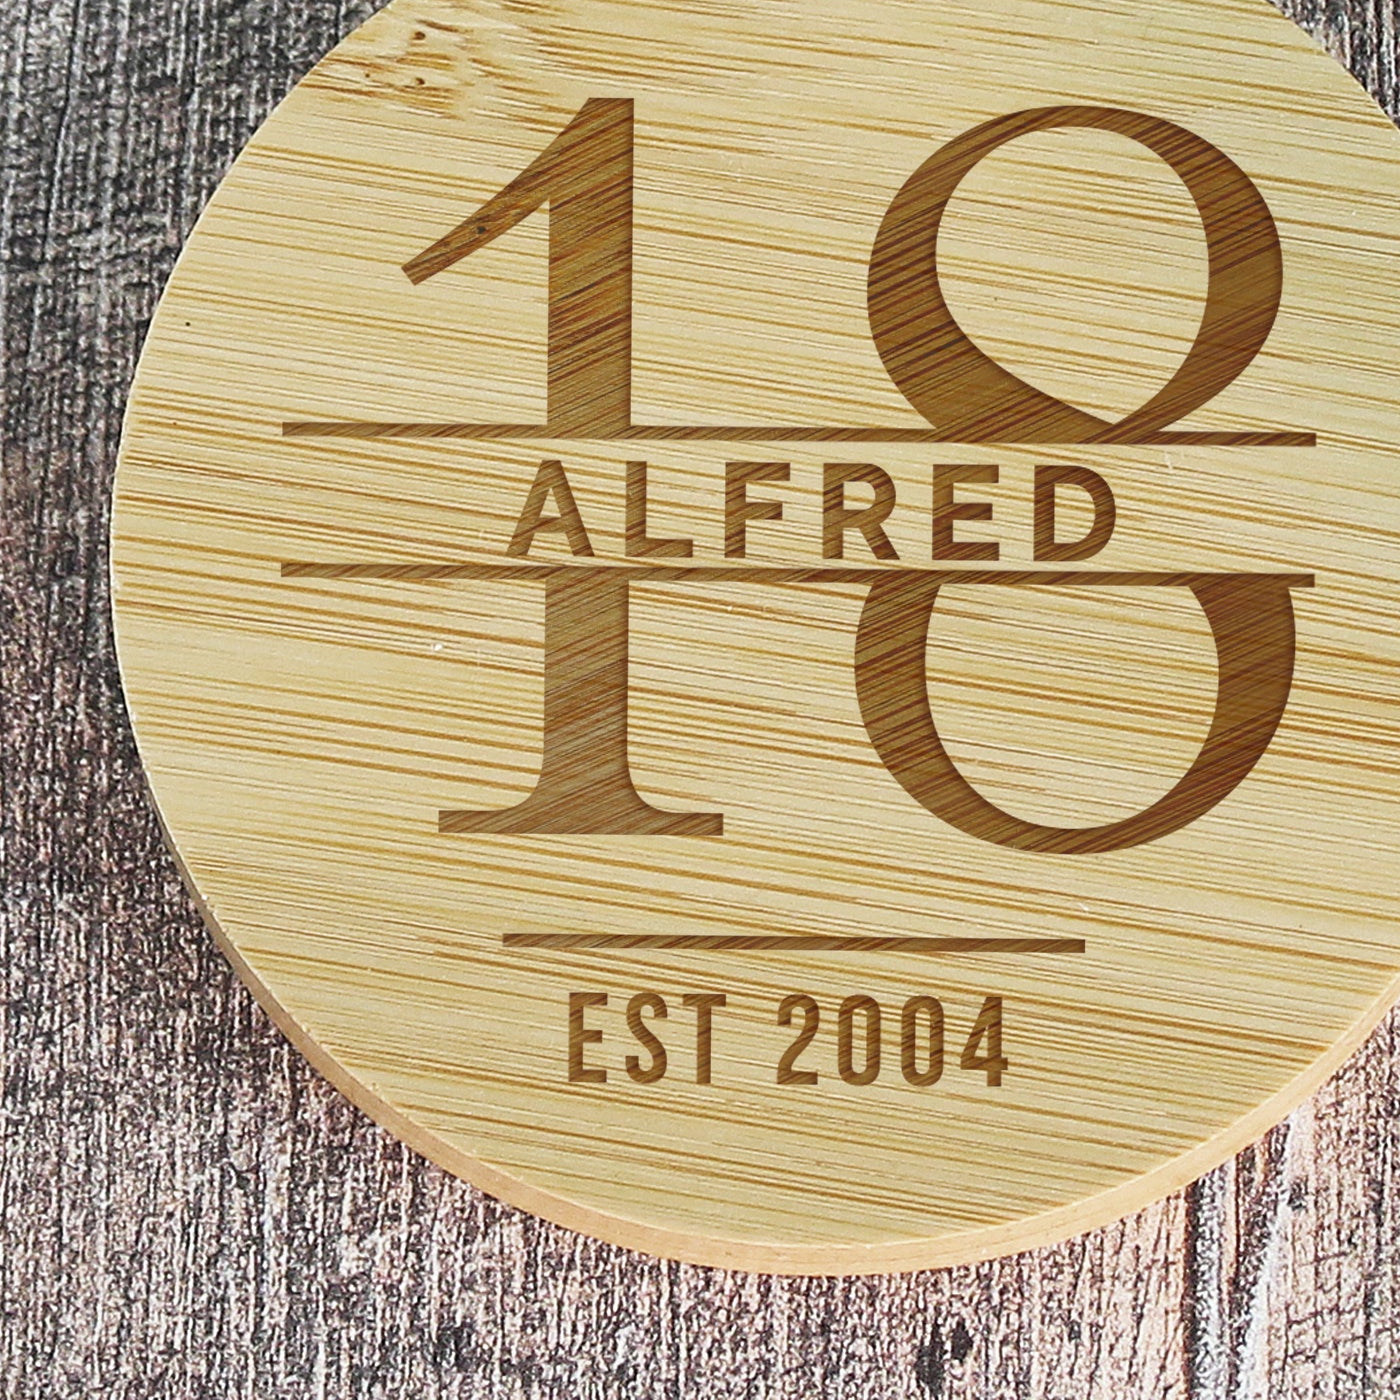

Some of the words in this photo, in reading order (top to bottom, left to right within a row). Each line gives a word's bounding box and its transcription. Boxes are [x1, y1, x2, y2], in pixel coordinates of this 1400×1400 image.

[401, 97, 1297, 855] 18
[507, 459, 1117, 561] ALFRED
[568, 991, 728, 1084] EST
[776, 994, 1009, 1087] 2004
